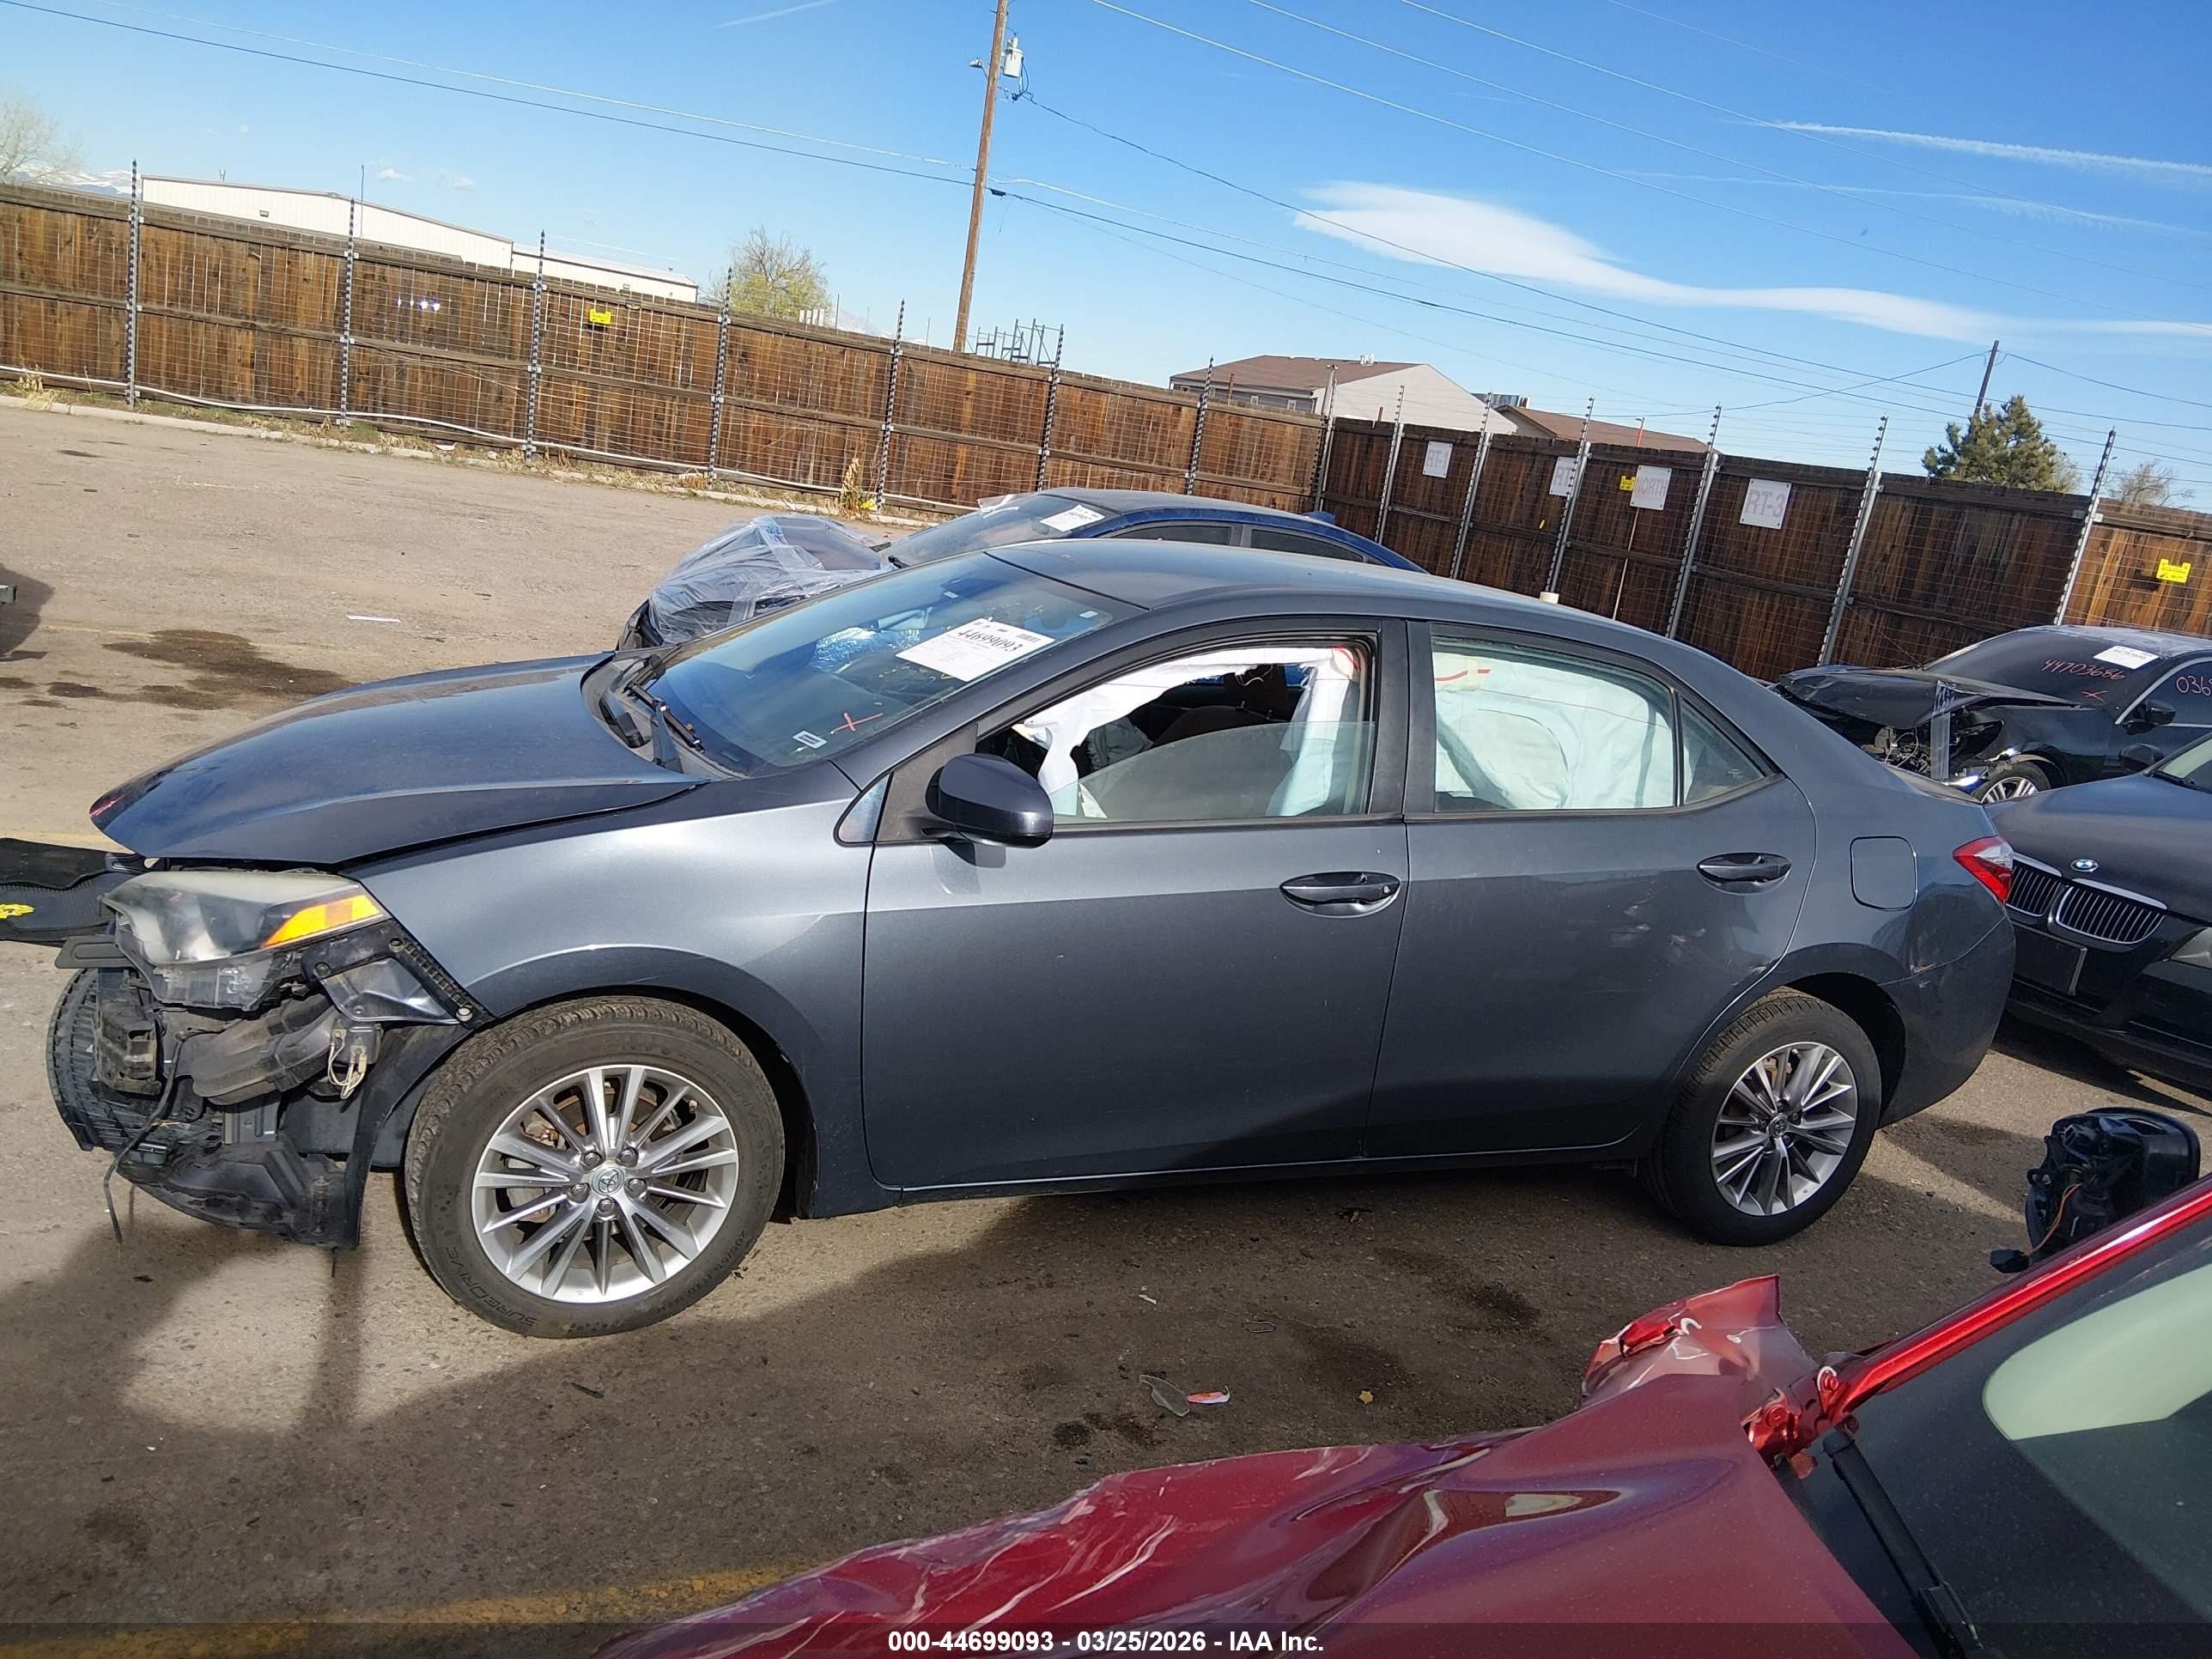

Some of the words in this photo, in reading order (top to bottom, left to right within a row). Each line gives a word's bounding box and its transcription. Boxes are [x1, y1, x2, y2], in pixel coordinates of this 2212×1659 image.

[1633, 477, 1668, 496] NORTH
[1744, 489, 1786, 517] RT-3
[957, 629, 1024, 653] 44699093
[2041, 659, 2126, 680] 44703686
[447, 1247, 538, 1327] SUREDRIVE
